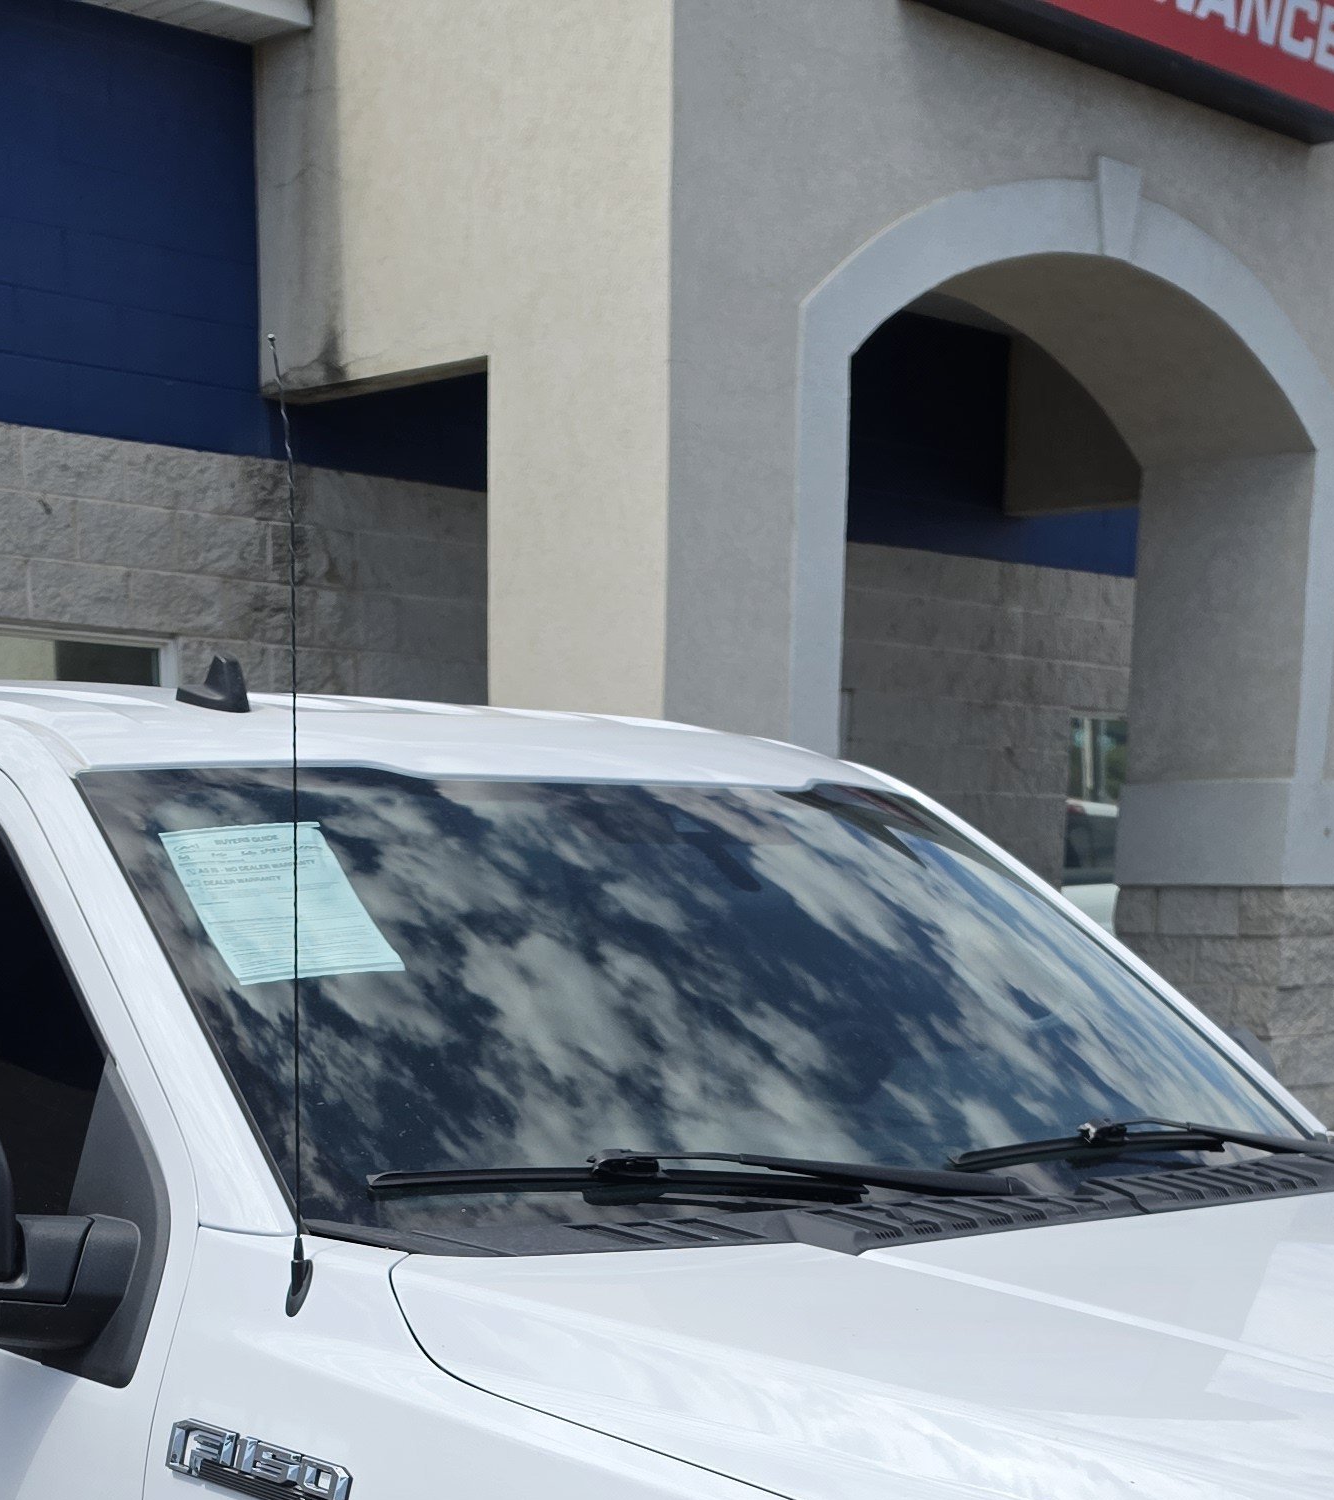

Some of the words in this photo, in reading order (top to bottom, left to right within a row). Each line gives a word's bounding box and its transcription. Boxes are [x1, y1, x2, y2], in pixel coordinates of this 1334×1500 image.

[251, 835, 279, 843] GUIDE
[238, 863, 271, 871] DEALER
[203, 878, 236, 886] DEALER
[236, 875, 281, 884] WARRANTY
